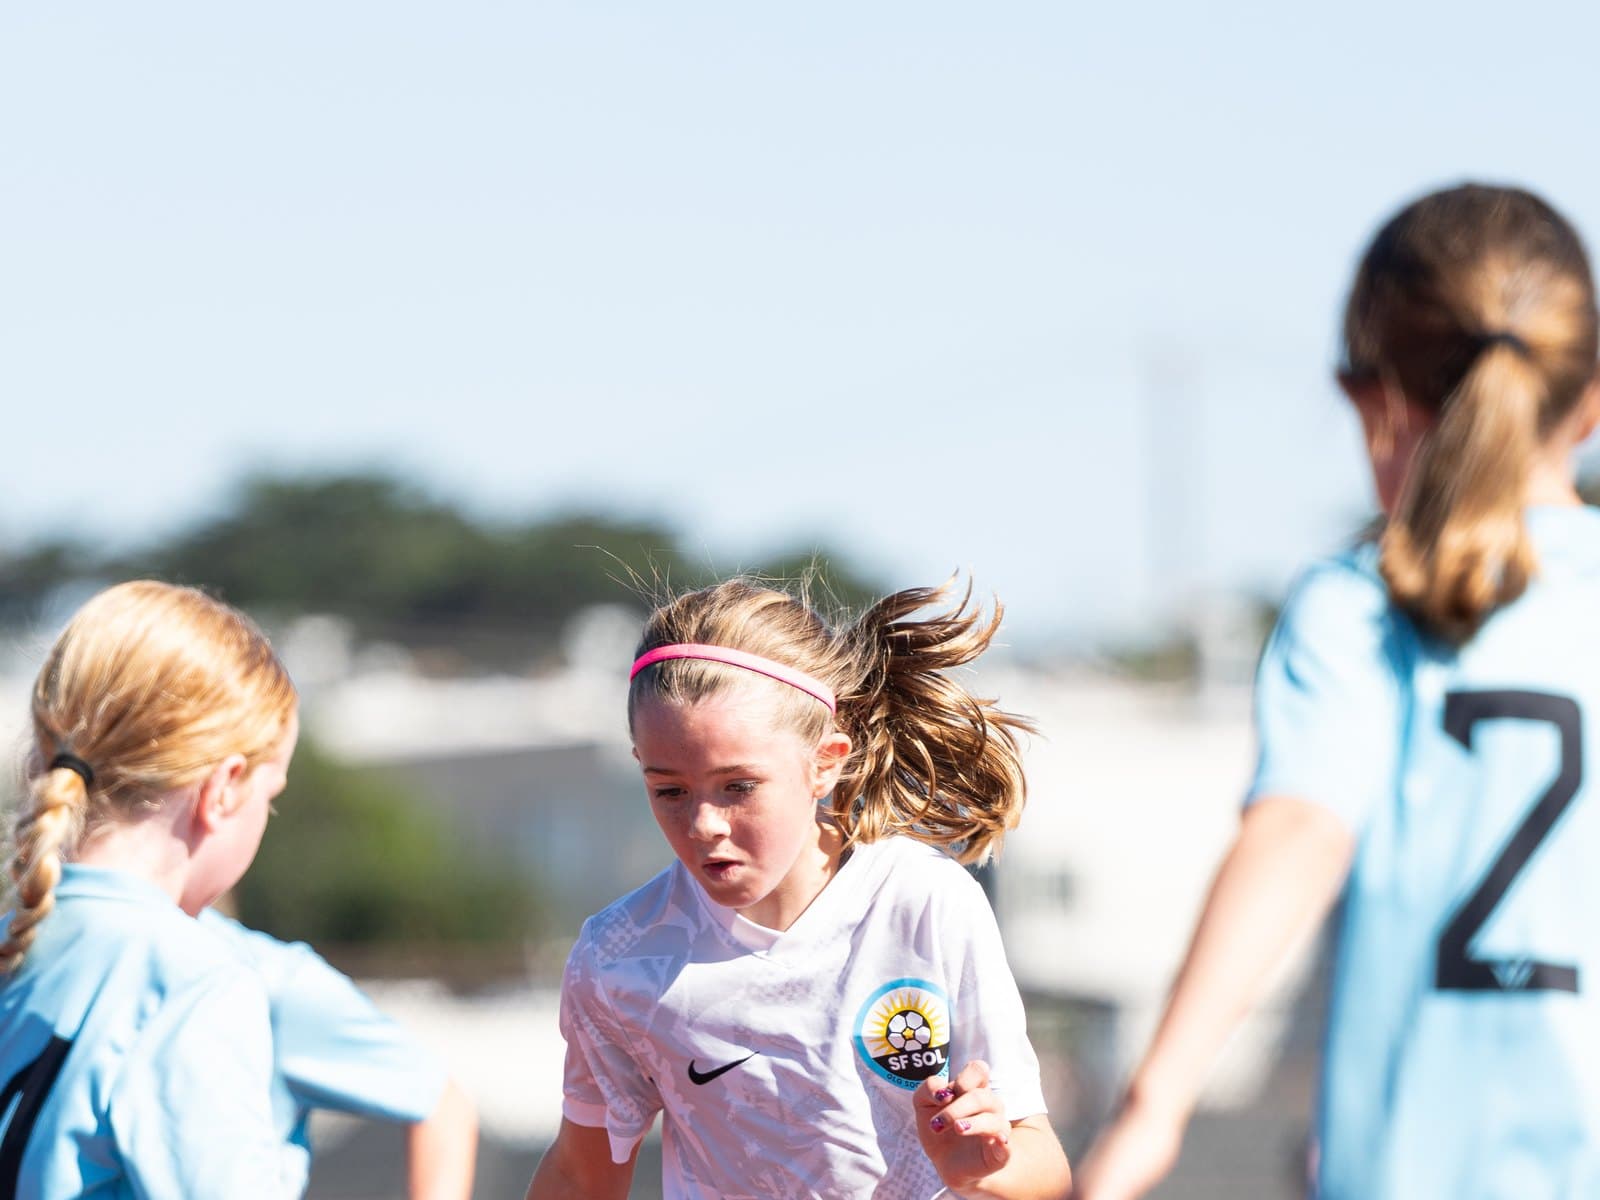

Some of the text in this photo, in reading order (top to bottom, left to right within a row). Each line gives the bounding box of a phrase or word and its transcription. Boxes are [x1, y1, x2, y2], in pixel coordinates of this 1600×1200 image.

[1436, 690, 1582, 992] 2
[888, 1049, 946, 1071] SF SOL
